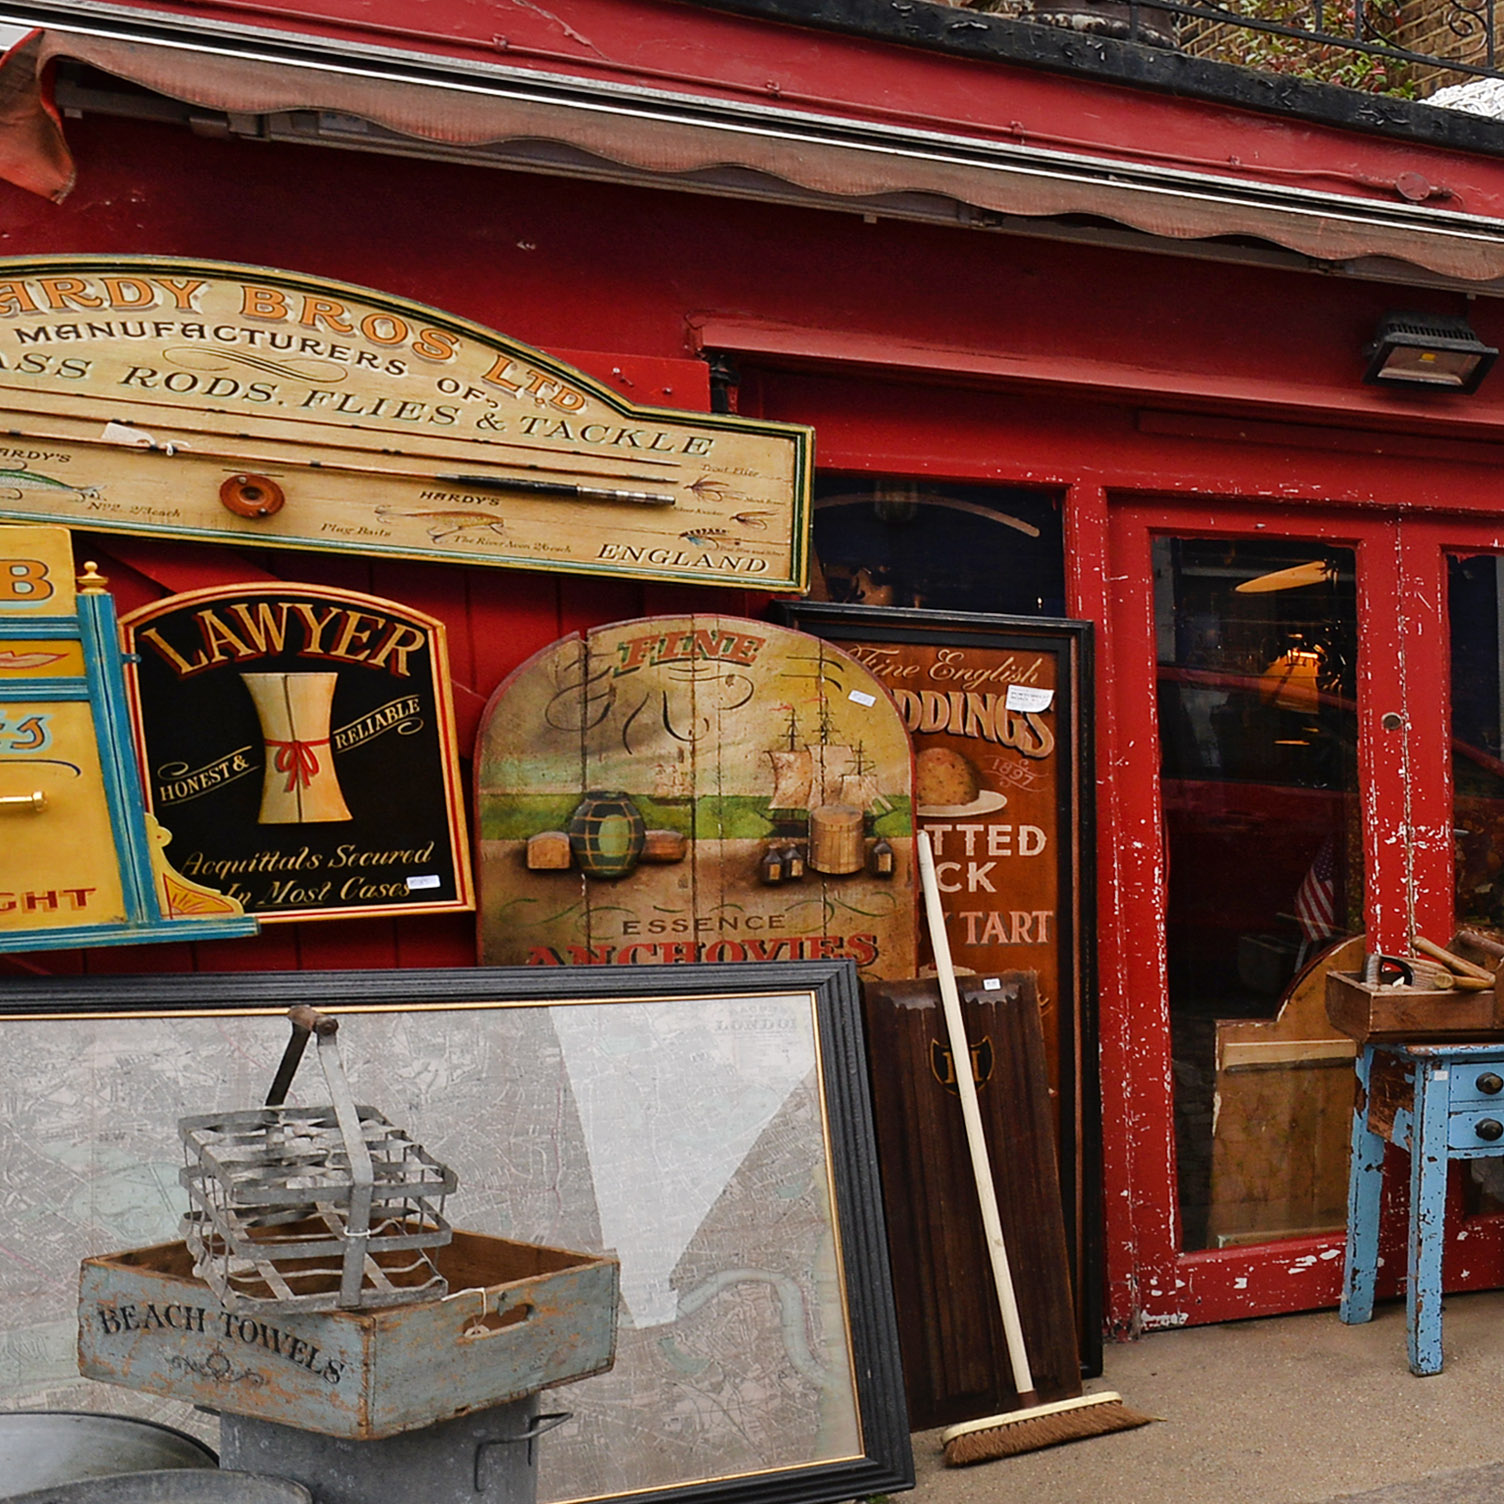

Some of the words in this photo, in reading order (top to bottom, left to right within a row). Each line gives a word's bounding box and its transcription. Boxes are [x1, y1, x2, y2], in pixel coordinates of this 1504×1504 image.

[15, 320, 408, 377] MANUFACTURERS
[239, 285, 460, 362] BROS
[481, 354, 587, 414] LTD
[301, 389, 463, 426] FLIES
[476, 412, 506, 432] &
[520, 415, 714, 458] TACKLE
[419, 490, 501, 506] HARDY'S
[596, 543, 770, 575] ENGLAND
[141, 601, 426, 680] LAWYER
[614, 629, 767, 677] FINE
[848, 644, 921, 679] Fine
[929, 648, 1043, 689] English
[335, 696, 421, 750] RELIABLE
[159, 760, 231, 803] HONEST
[232, 753, 251, 772] &
[991, 757, 1036, 786] 1897
[180, 846, 324, 881] Acquittals
[328, 840, 435, 868] Secured
[222, 881, 251, 907] In
[256, 876, 332, 907] Most
[338, 874, 412, 901] Cases
[622, 914, 787, 937] ESSENCE
[959, 909, 1055, 945] TART
[99, 1302, 206, 1336] BEACH
[219, 1310, 346, 1386] TOWELS
